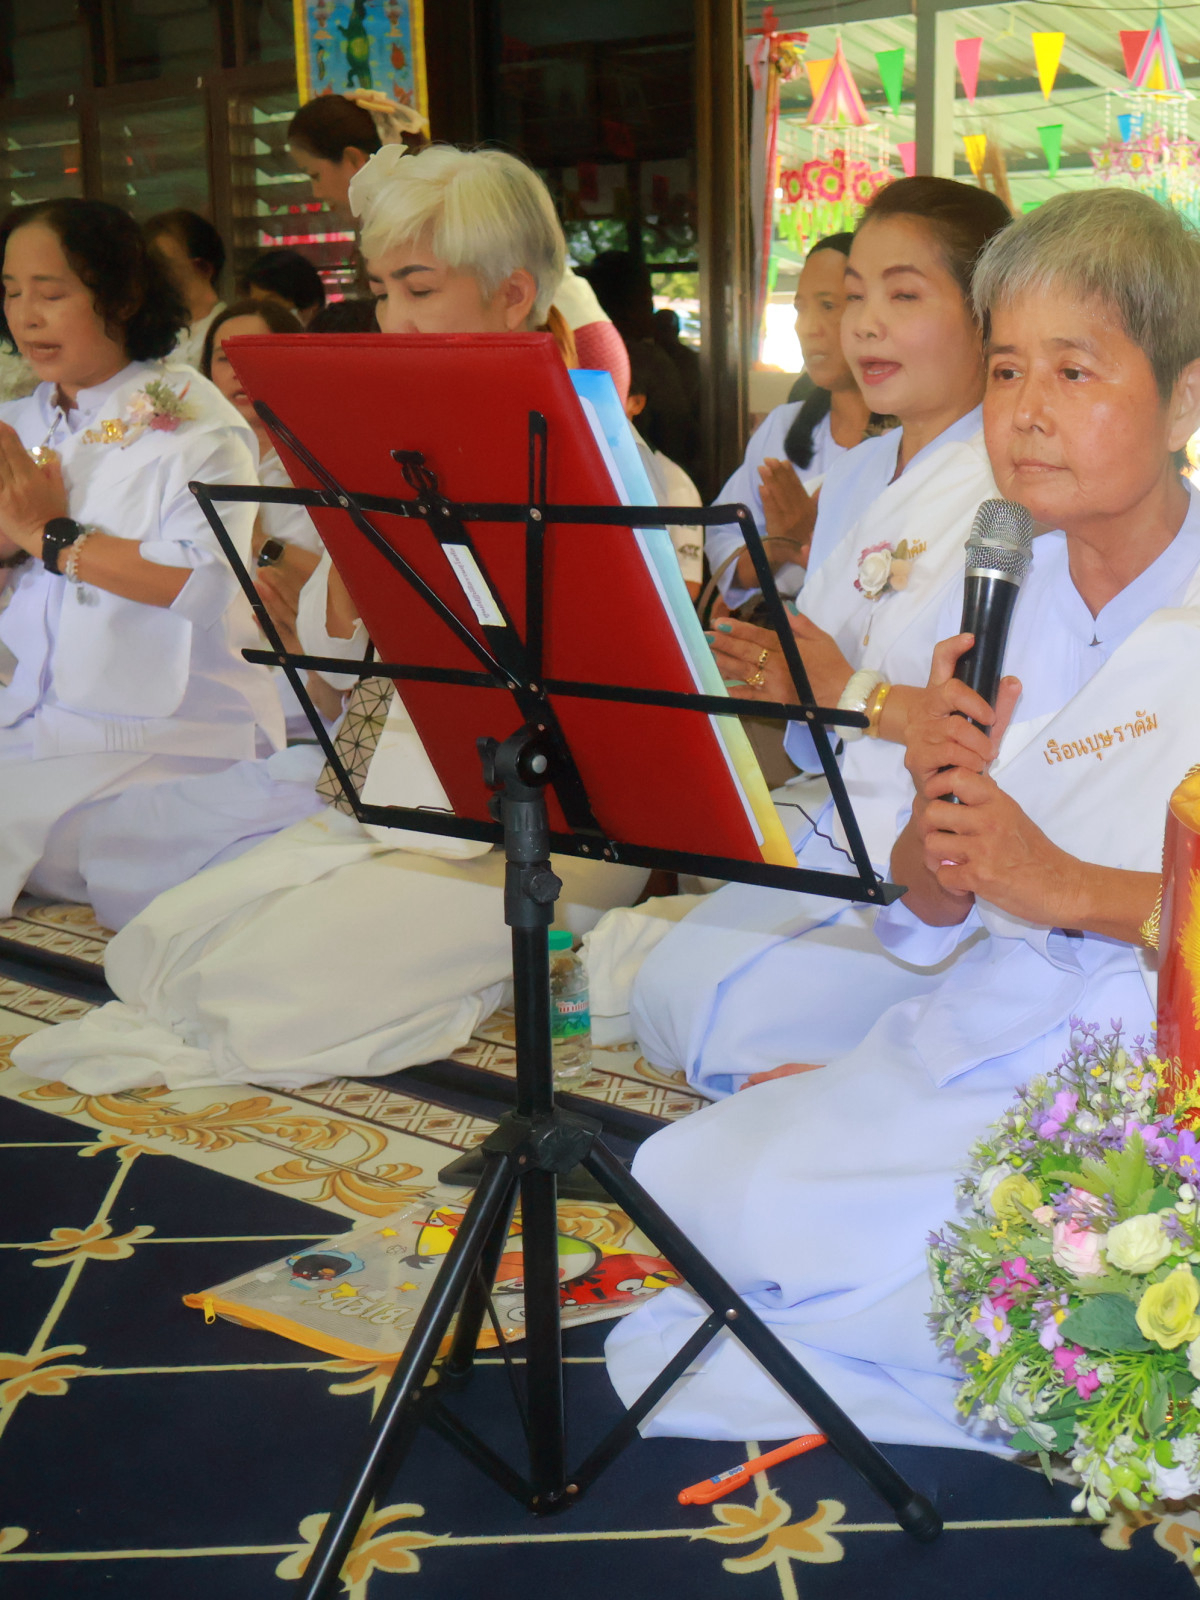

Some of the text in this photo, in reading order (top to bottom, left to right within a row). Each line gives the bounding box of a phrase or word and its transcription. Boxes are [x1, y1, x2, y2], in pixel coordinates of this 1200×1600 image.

[1043, 710, 1158, 765] เรือนบุษราคัม
